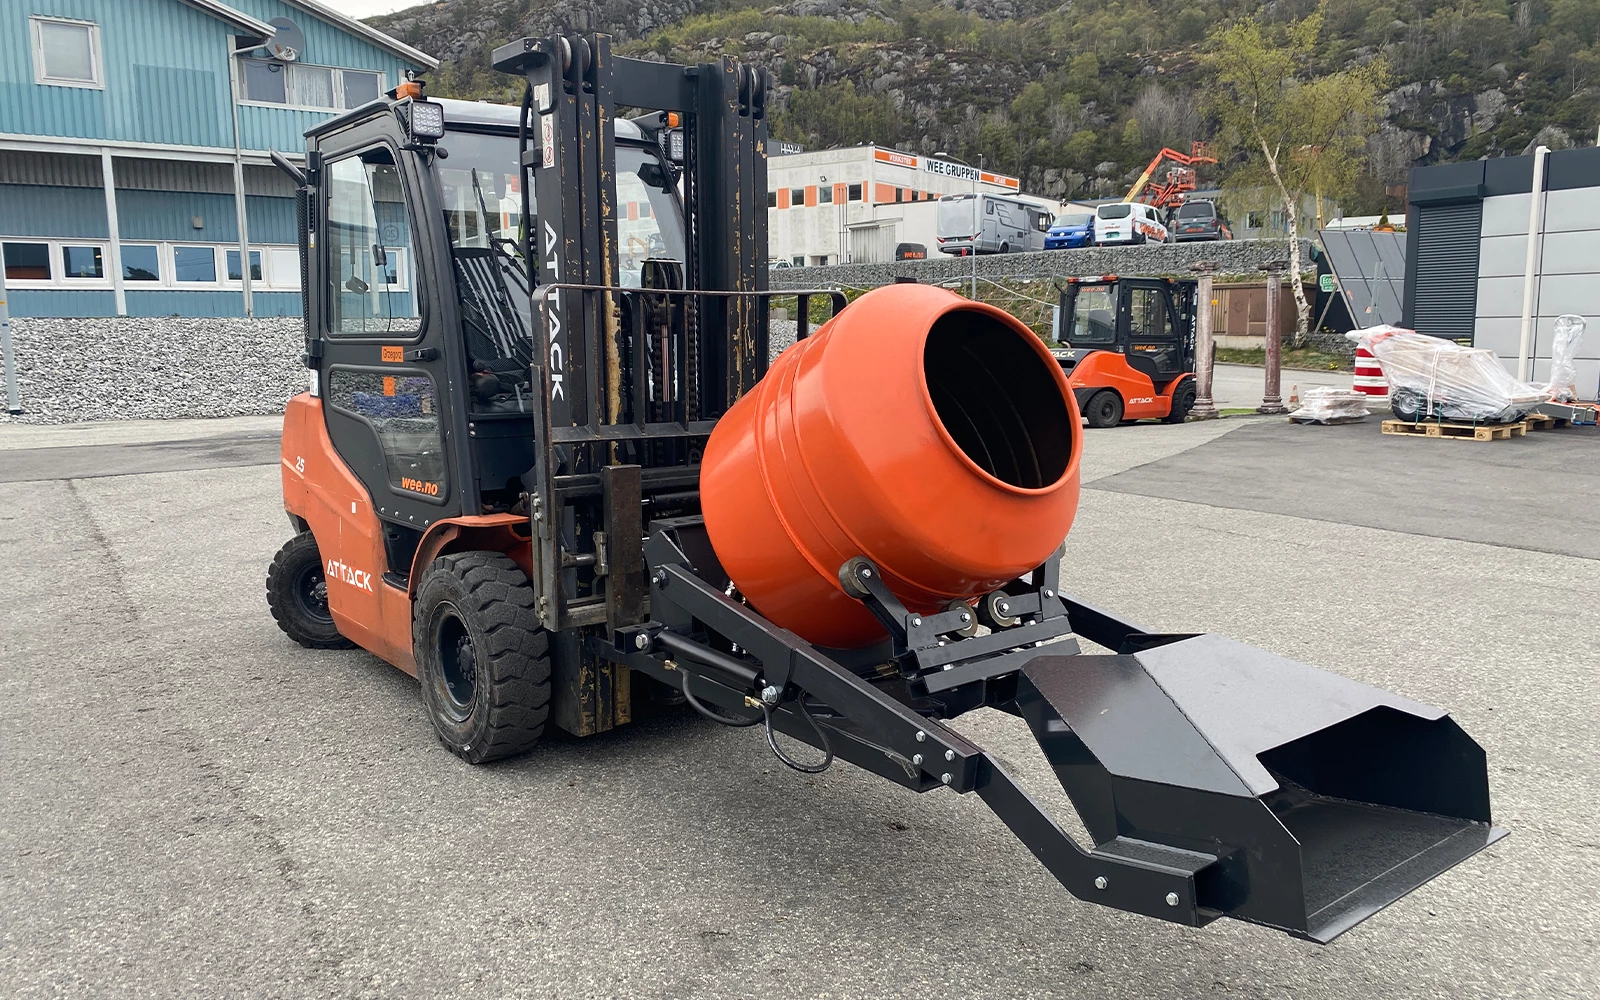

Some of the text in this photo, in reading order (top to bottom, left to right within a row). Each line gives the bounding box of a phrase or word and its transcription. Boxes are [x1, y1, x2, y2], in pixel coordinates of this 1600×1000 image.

[926, 160, 980, 180] WEE GRUPPEN
[1139, 223, 1165, 240] wee.no
[544, 219, 564, 401] ATTACK
[1051, 350, 1076, 358] TACK
[295, 456, 305, 473] 25
[401, 476, 439, 496] wee.no
[326, 558, 373, 592] ATTACK
